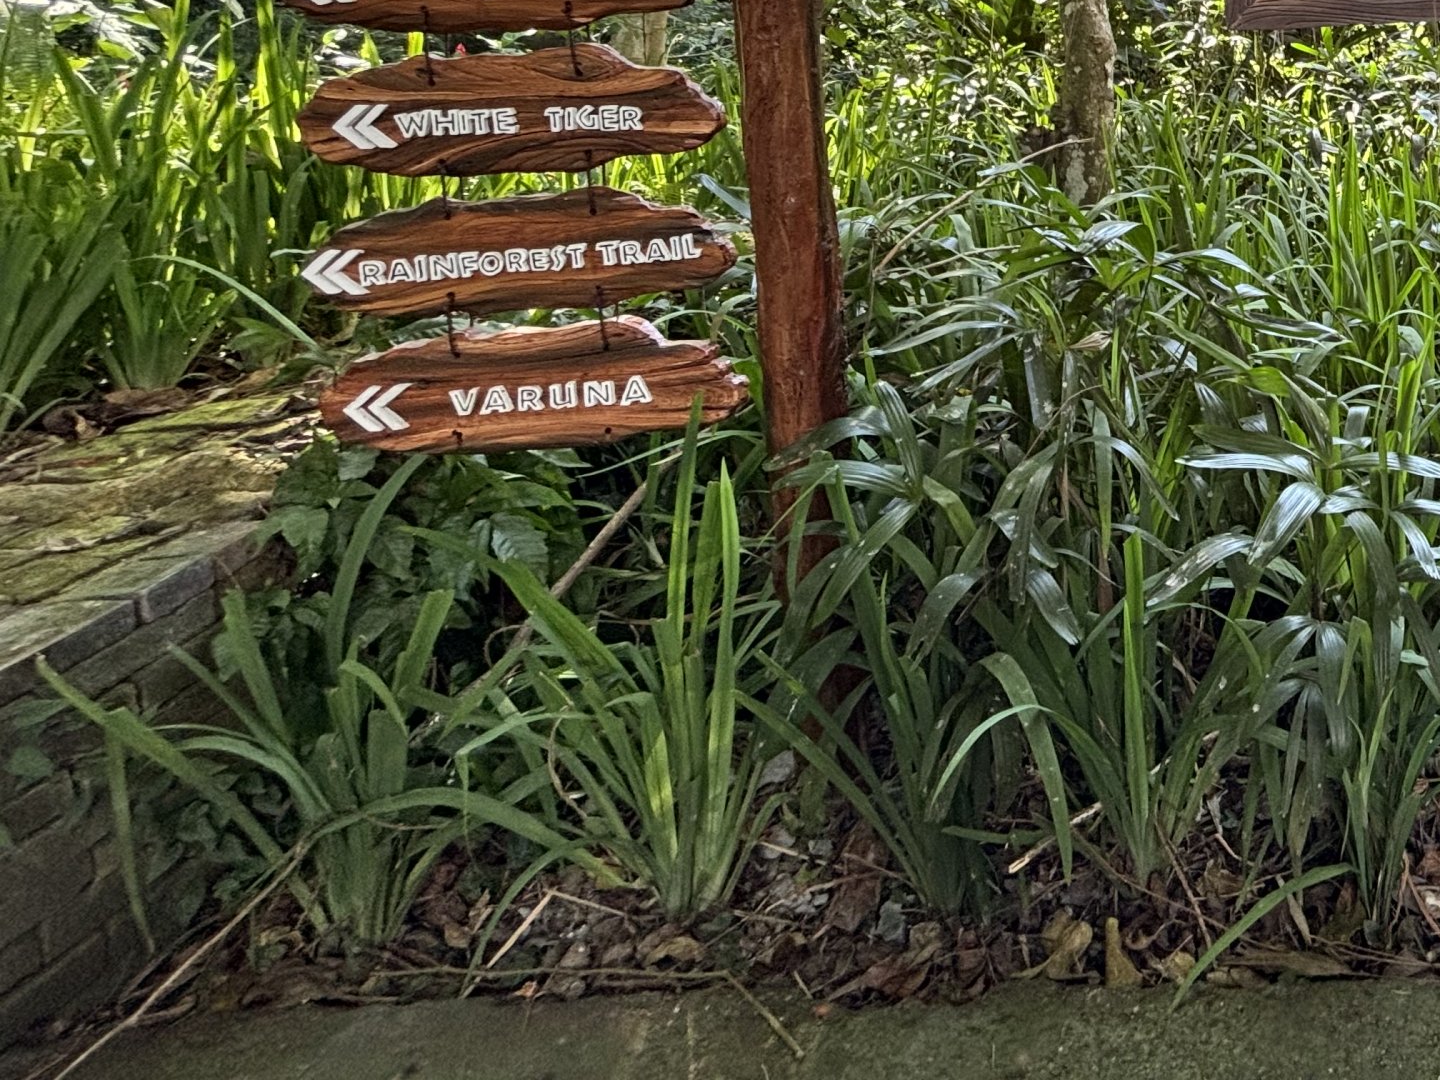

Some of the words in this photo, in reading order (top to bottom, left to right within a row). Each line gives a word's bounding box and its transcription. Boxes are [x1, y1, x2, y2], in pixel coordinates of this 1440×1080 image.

[395, 108, 518, 137] WHITE
[545, 105, 644, 132] TIGER
[359, 244, 587, 286] RAINFOREST
[596, 233, 702, 267] TRAIL
[449, 376, 652, 415] VARUNA
